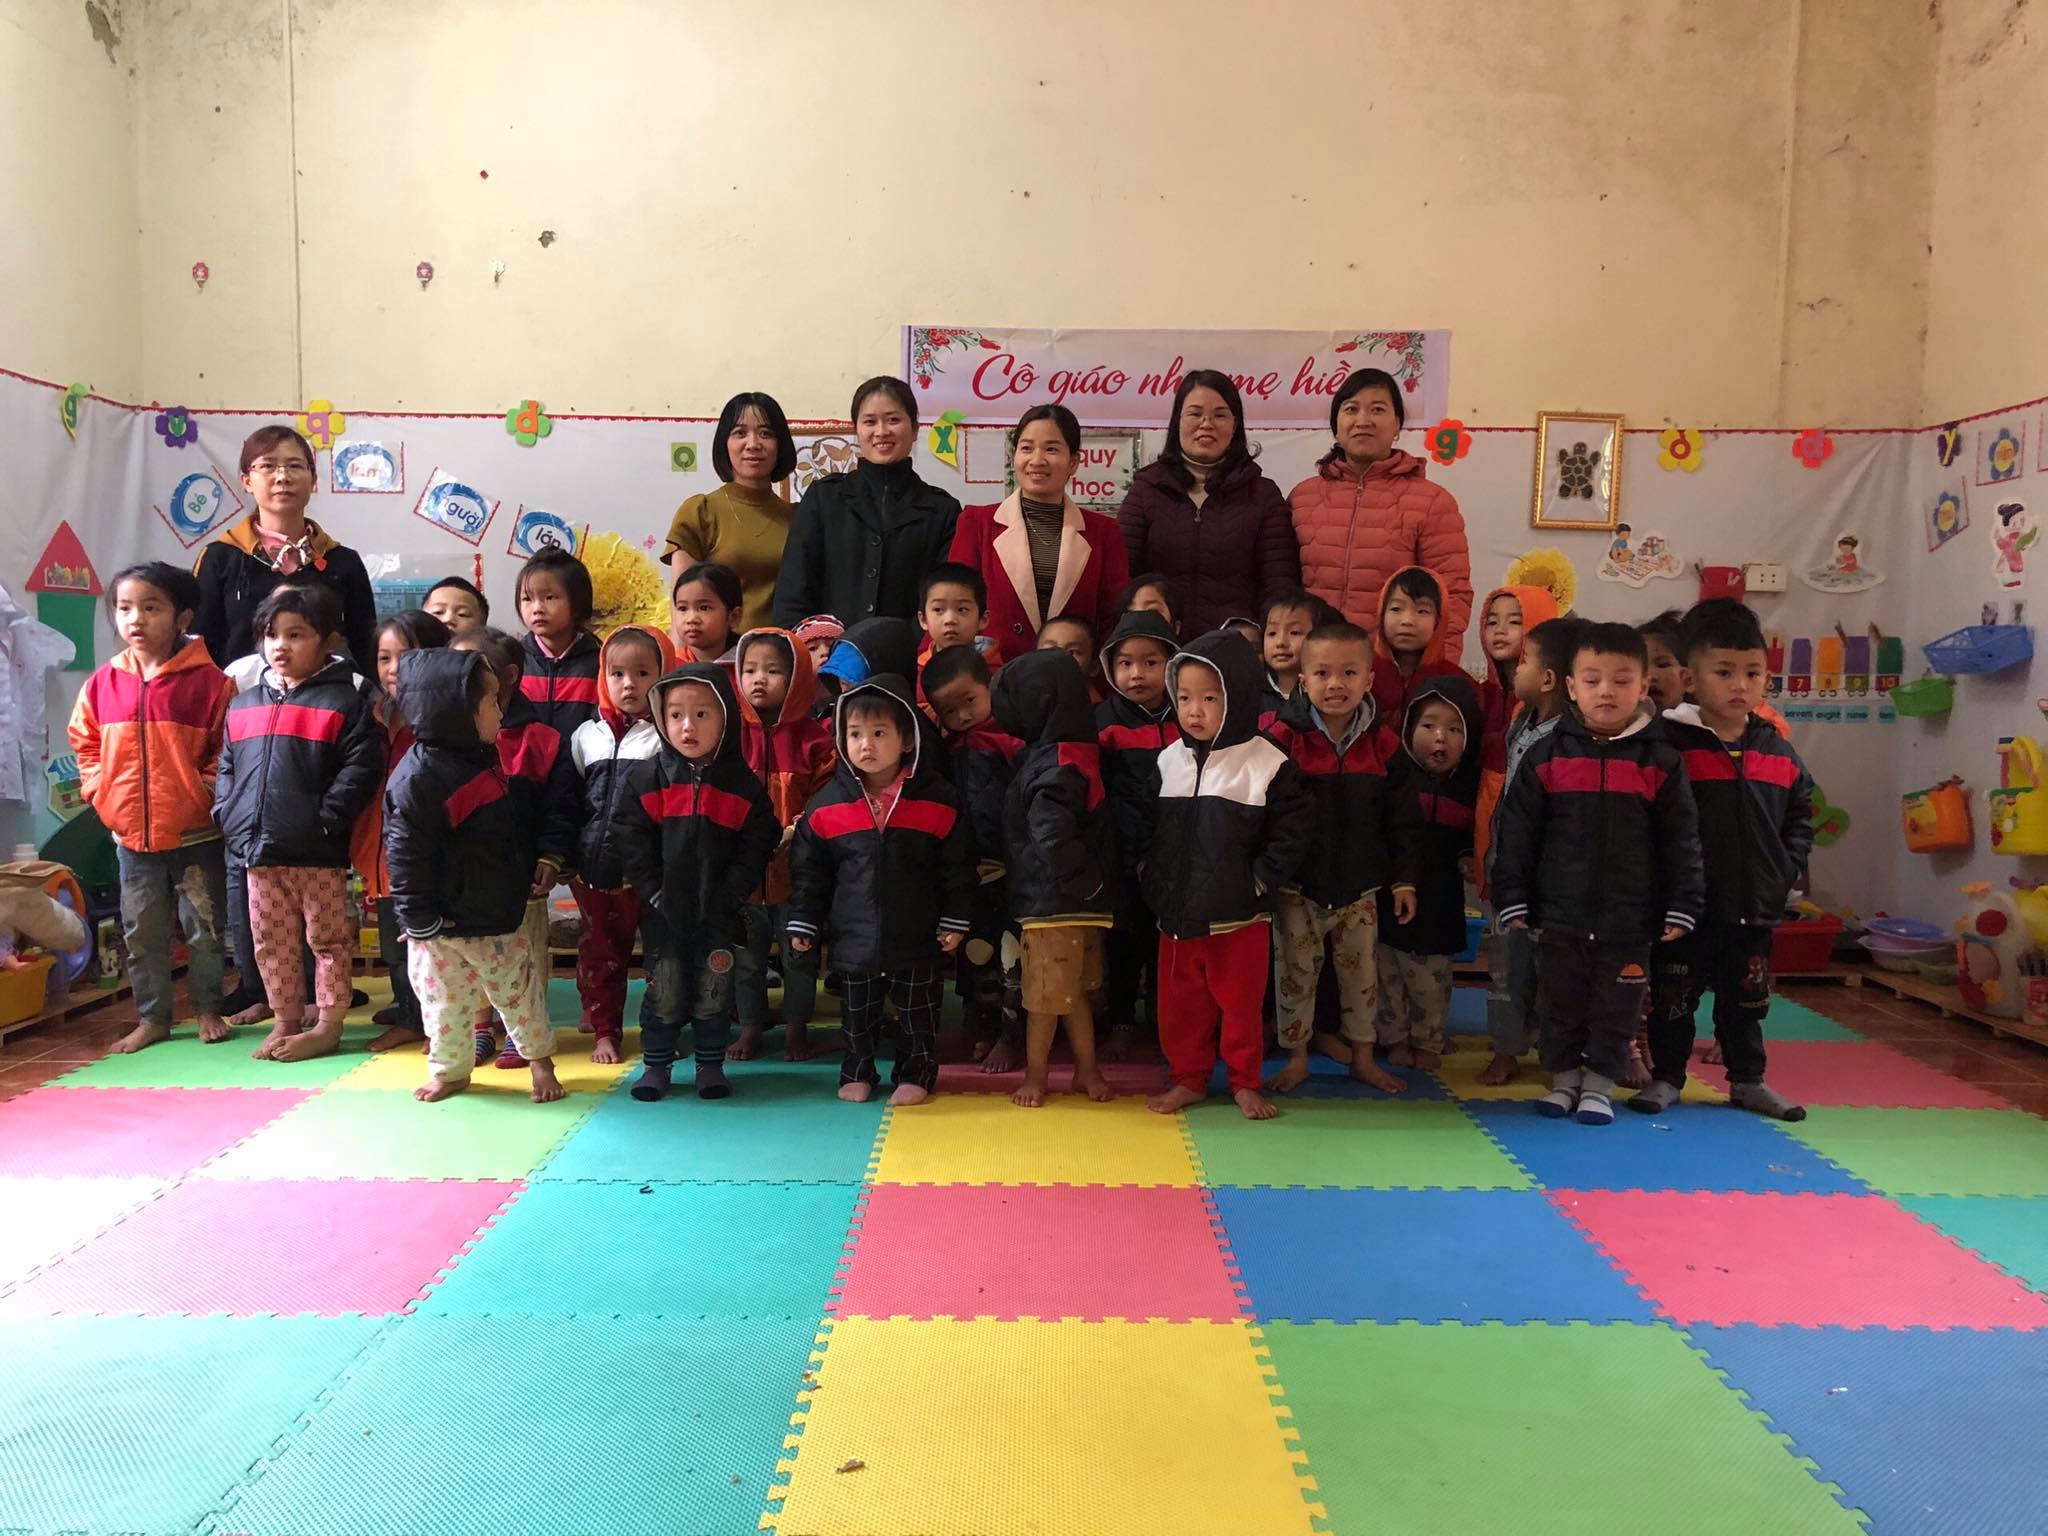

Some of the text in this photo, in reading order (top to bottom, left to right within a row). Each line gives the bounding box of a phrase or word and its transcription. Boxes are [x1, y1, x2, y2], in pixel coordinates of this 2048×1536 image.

[972, 354, 1040, 401] Cô
[1048, 365, 1131, 406] giáo
[1137, 356, 1184, 397] nh
[1290, 356, 1351, 396] hiề
[306, 412, 329, 444] q
[517, 400, 538, 432] d
[1077, 449, 1117, 468] quy
[1436, 428, 1459, 460] g
[1943, 427, 1957, 465] y
[188, 493, 207, 513] Bé
